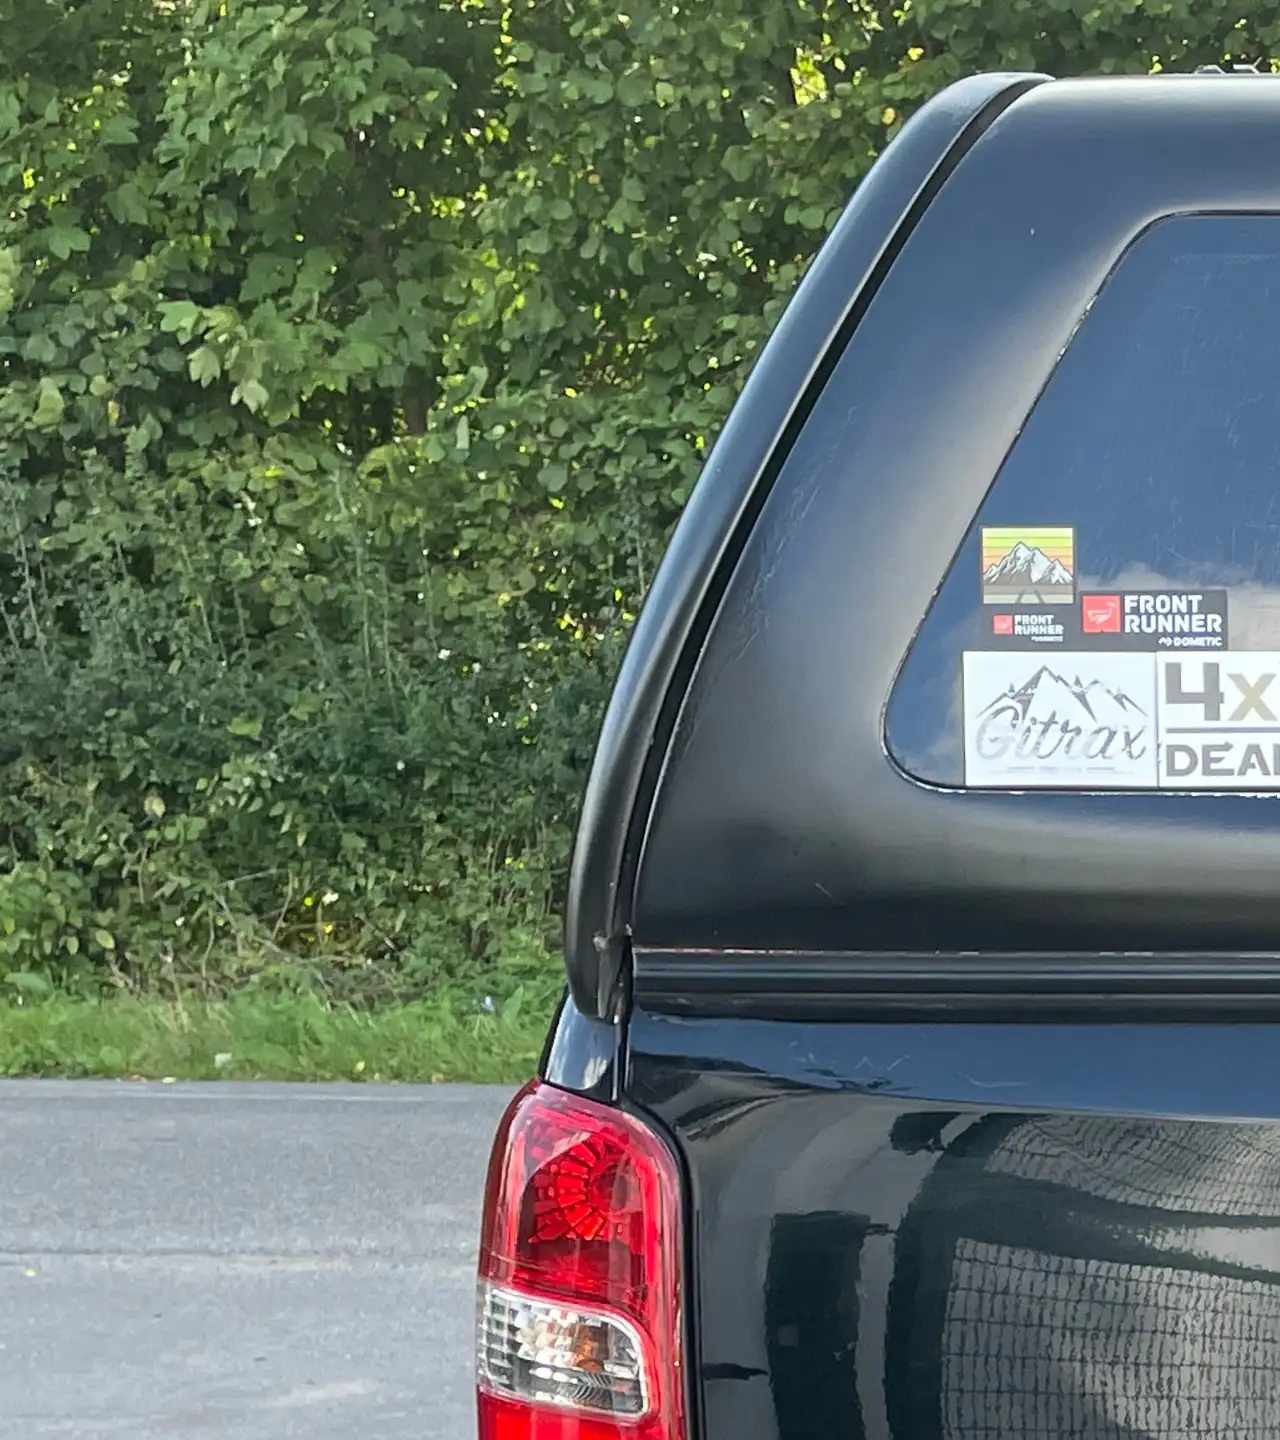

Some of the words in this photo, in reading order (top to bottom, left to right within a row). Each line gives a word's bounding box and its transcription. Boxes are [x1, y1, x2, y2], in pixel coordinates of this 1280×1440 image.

[1125, 594, 1202, 613] FRONT
[1014, 614, 1054, 625] FRONT
[1124, 614, 1222, 633] RUNNER
